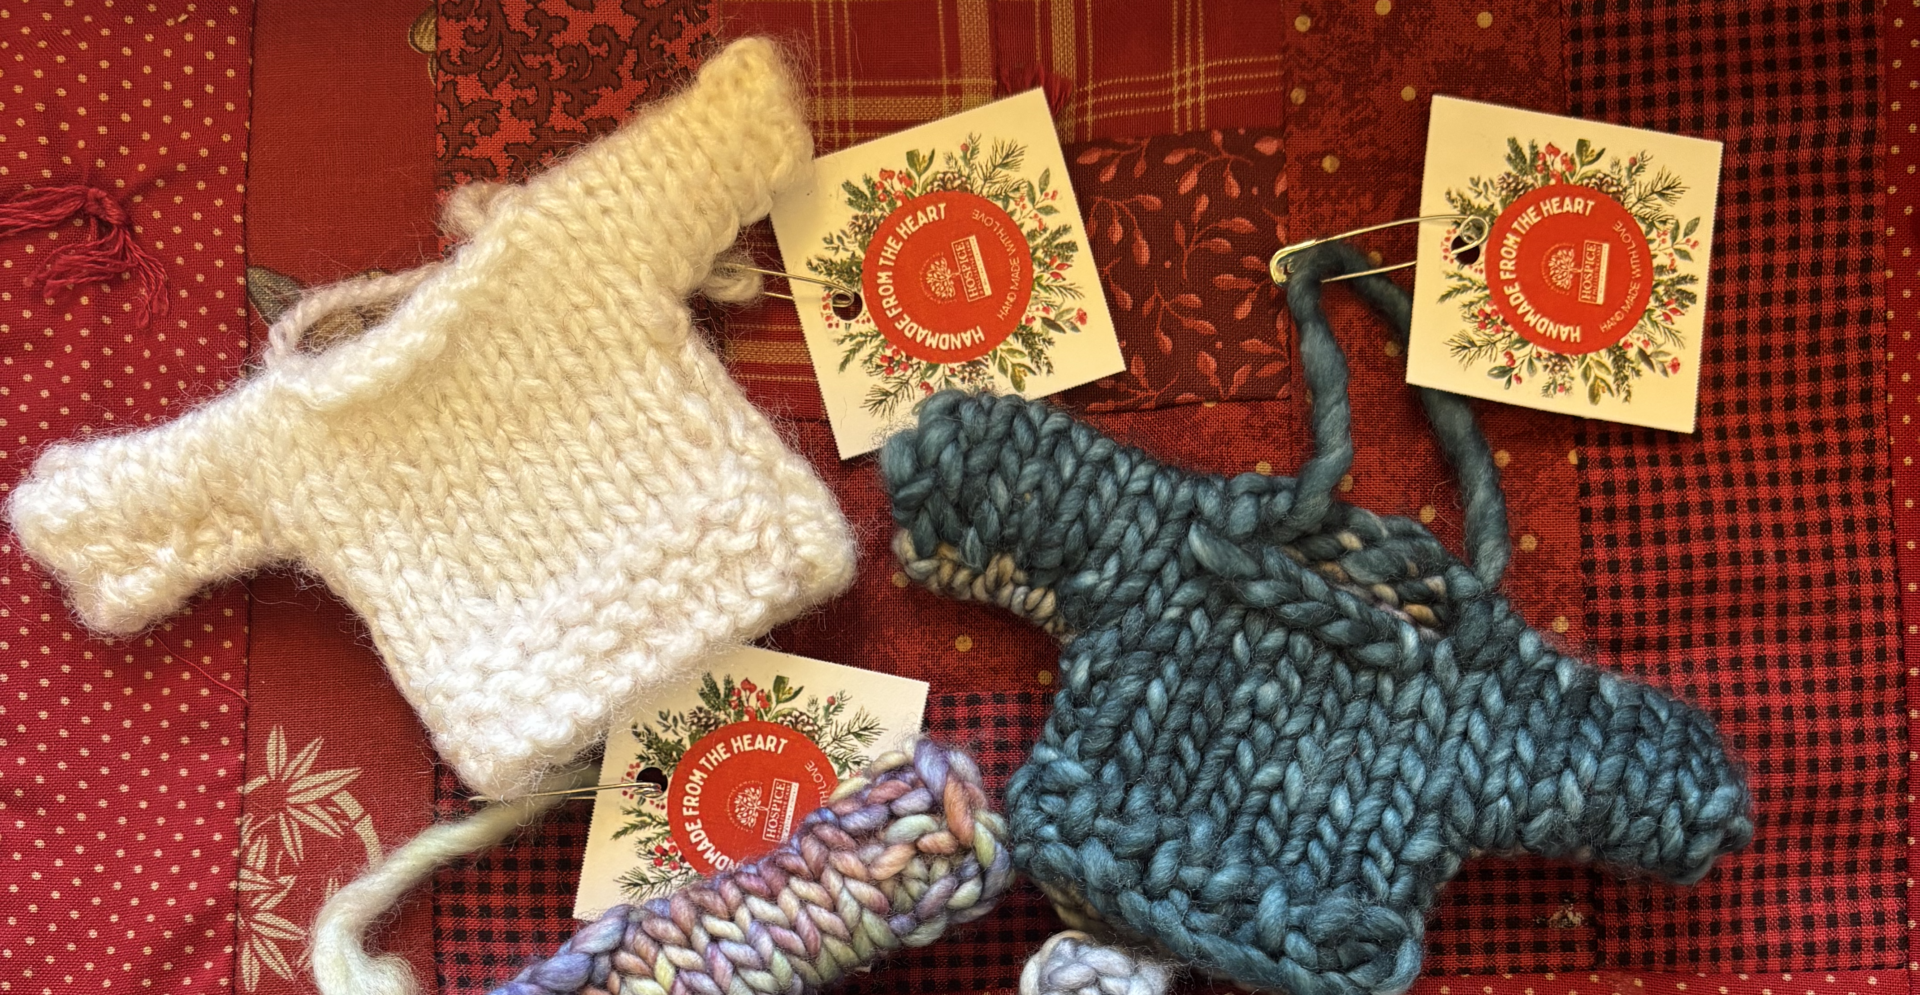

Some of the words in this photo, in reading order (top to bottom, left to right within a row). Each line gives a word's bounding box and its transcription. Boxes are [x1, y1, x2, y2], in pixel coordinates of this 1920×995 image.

[895, 203, 947, 241] HEART
[972, 208, 999, 232] LOVE
[1511, 205, 1542, 234] THE
[1540, 196, 1596, 217] HEART
[879, 235, 903, 267] THE
[996, 227, 1017, 257] WITH
[1612, 220, 1636, 251] LOVE
[954, 242, 979, 298] HOSPICE
[1009, 256, 1021, 291] MADE
[1500, 234, 1522, 281] FROM
[1581, 243, 1597, 300] HOSPICE
[1629, 250, 1642, 280] WITH
[876, 271, 902, 318] FROM
[997, 289, 1018, 321] HAND
[1623, 281, 1641, 311] MADE
[1503, 282, 1581, 343] HANDMADE
[1600, 311, 1625, 333] HAND
[895, 314, 985, 350] HANDMADE
[699, 742, 731, 771] THE
[730, 734, 788, 755] HEART
[804, 760, 827, 790] LOVE
[682, 768, 708, 816] FROM
[766, 782, 786, 838] HOSPICE
[684, 818, 741, 873] NDMADE
